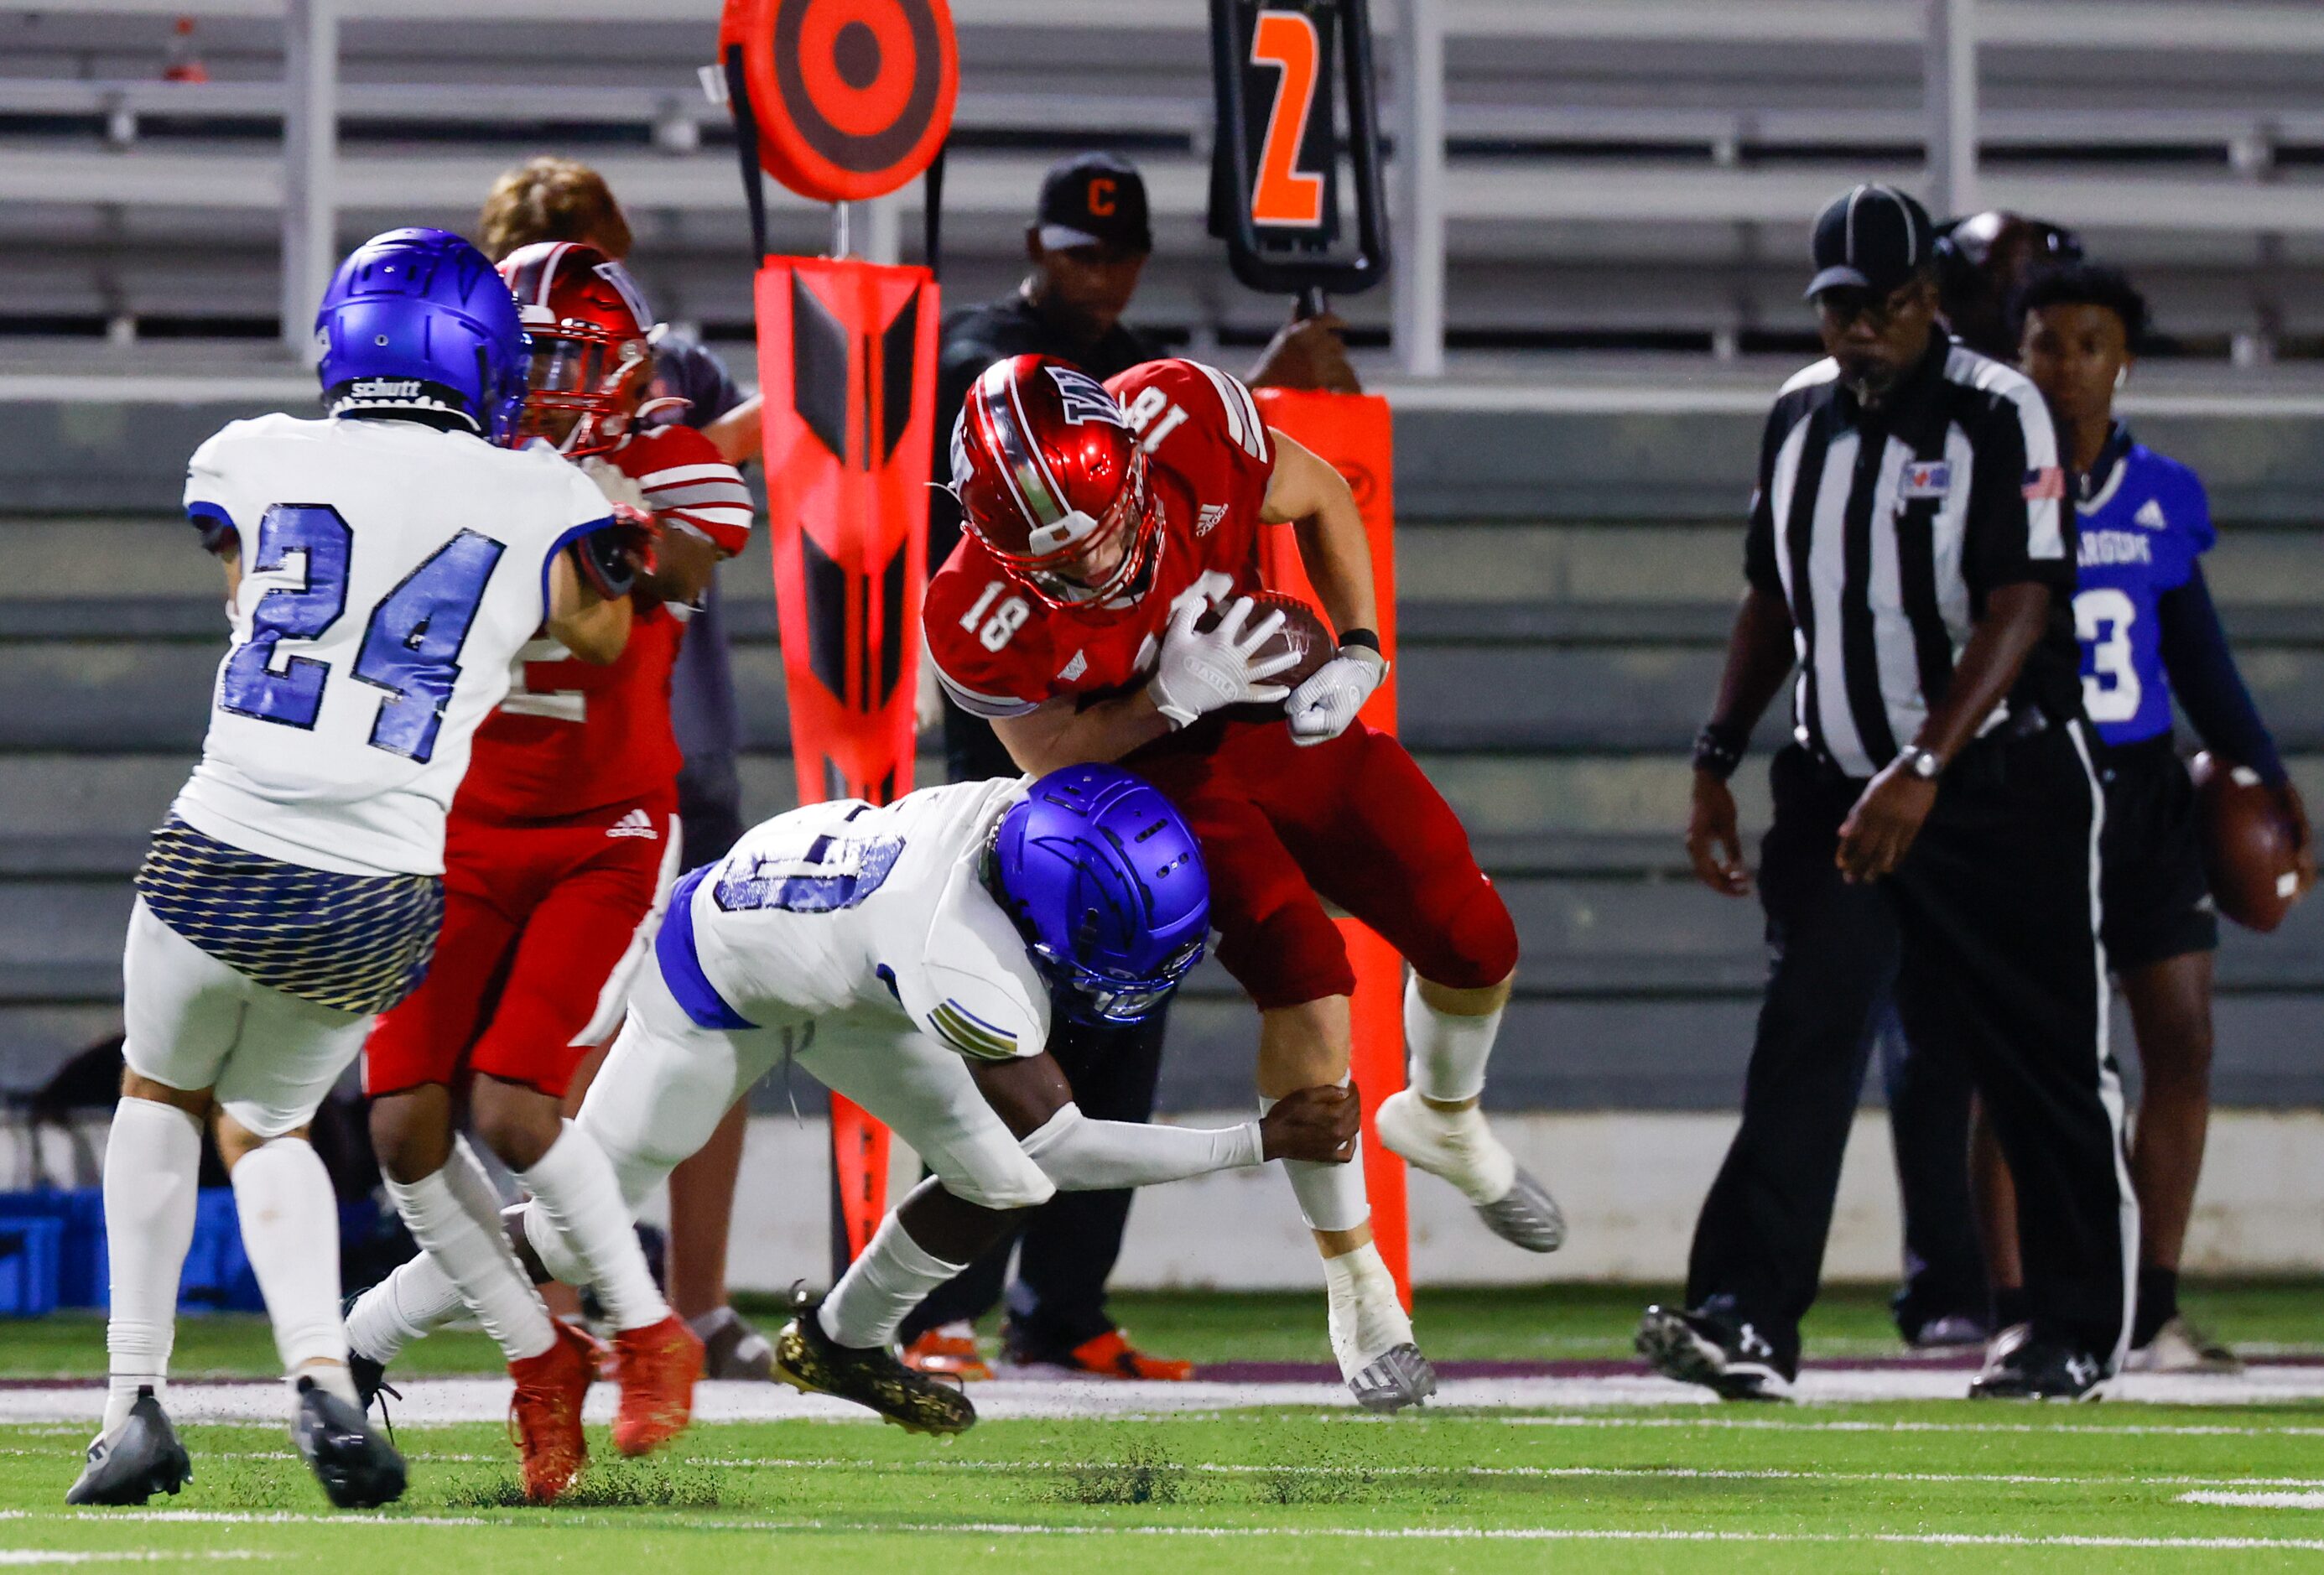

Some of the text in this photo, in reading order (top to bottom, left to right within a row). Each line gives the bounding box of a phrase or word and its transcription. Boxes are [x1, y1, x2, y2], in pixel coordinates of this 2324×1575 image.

[1250, 10, 1325, 228] 2
[1087, 177, 1115, 216] C
[351, 377, 422, 398] schutt
[1044, 366, 1125, 429] W
[1196, 503, 1230, 538] adidas
[218, 502, 507, 765] 24
[959, 580, 1031, 653] 18
